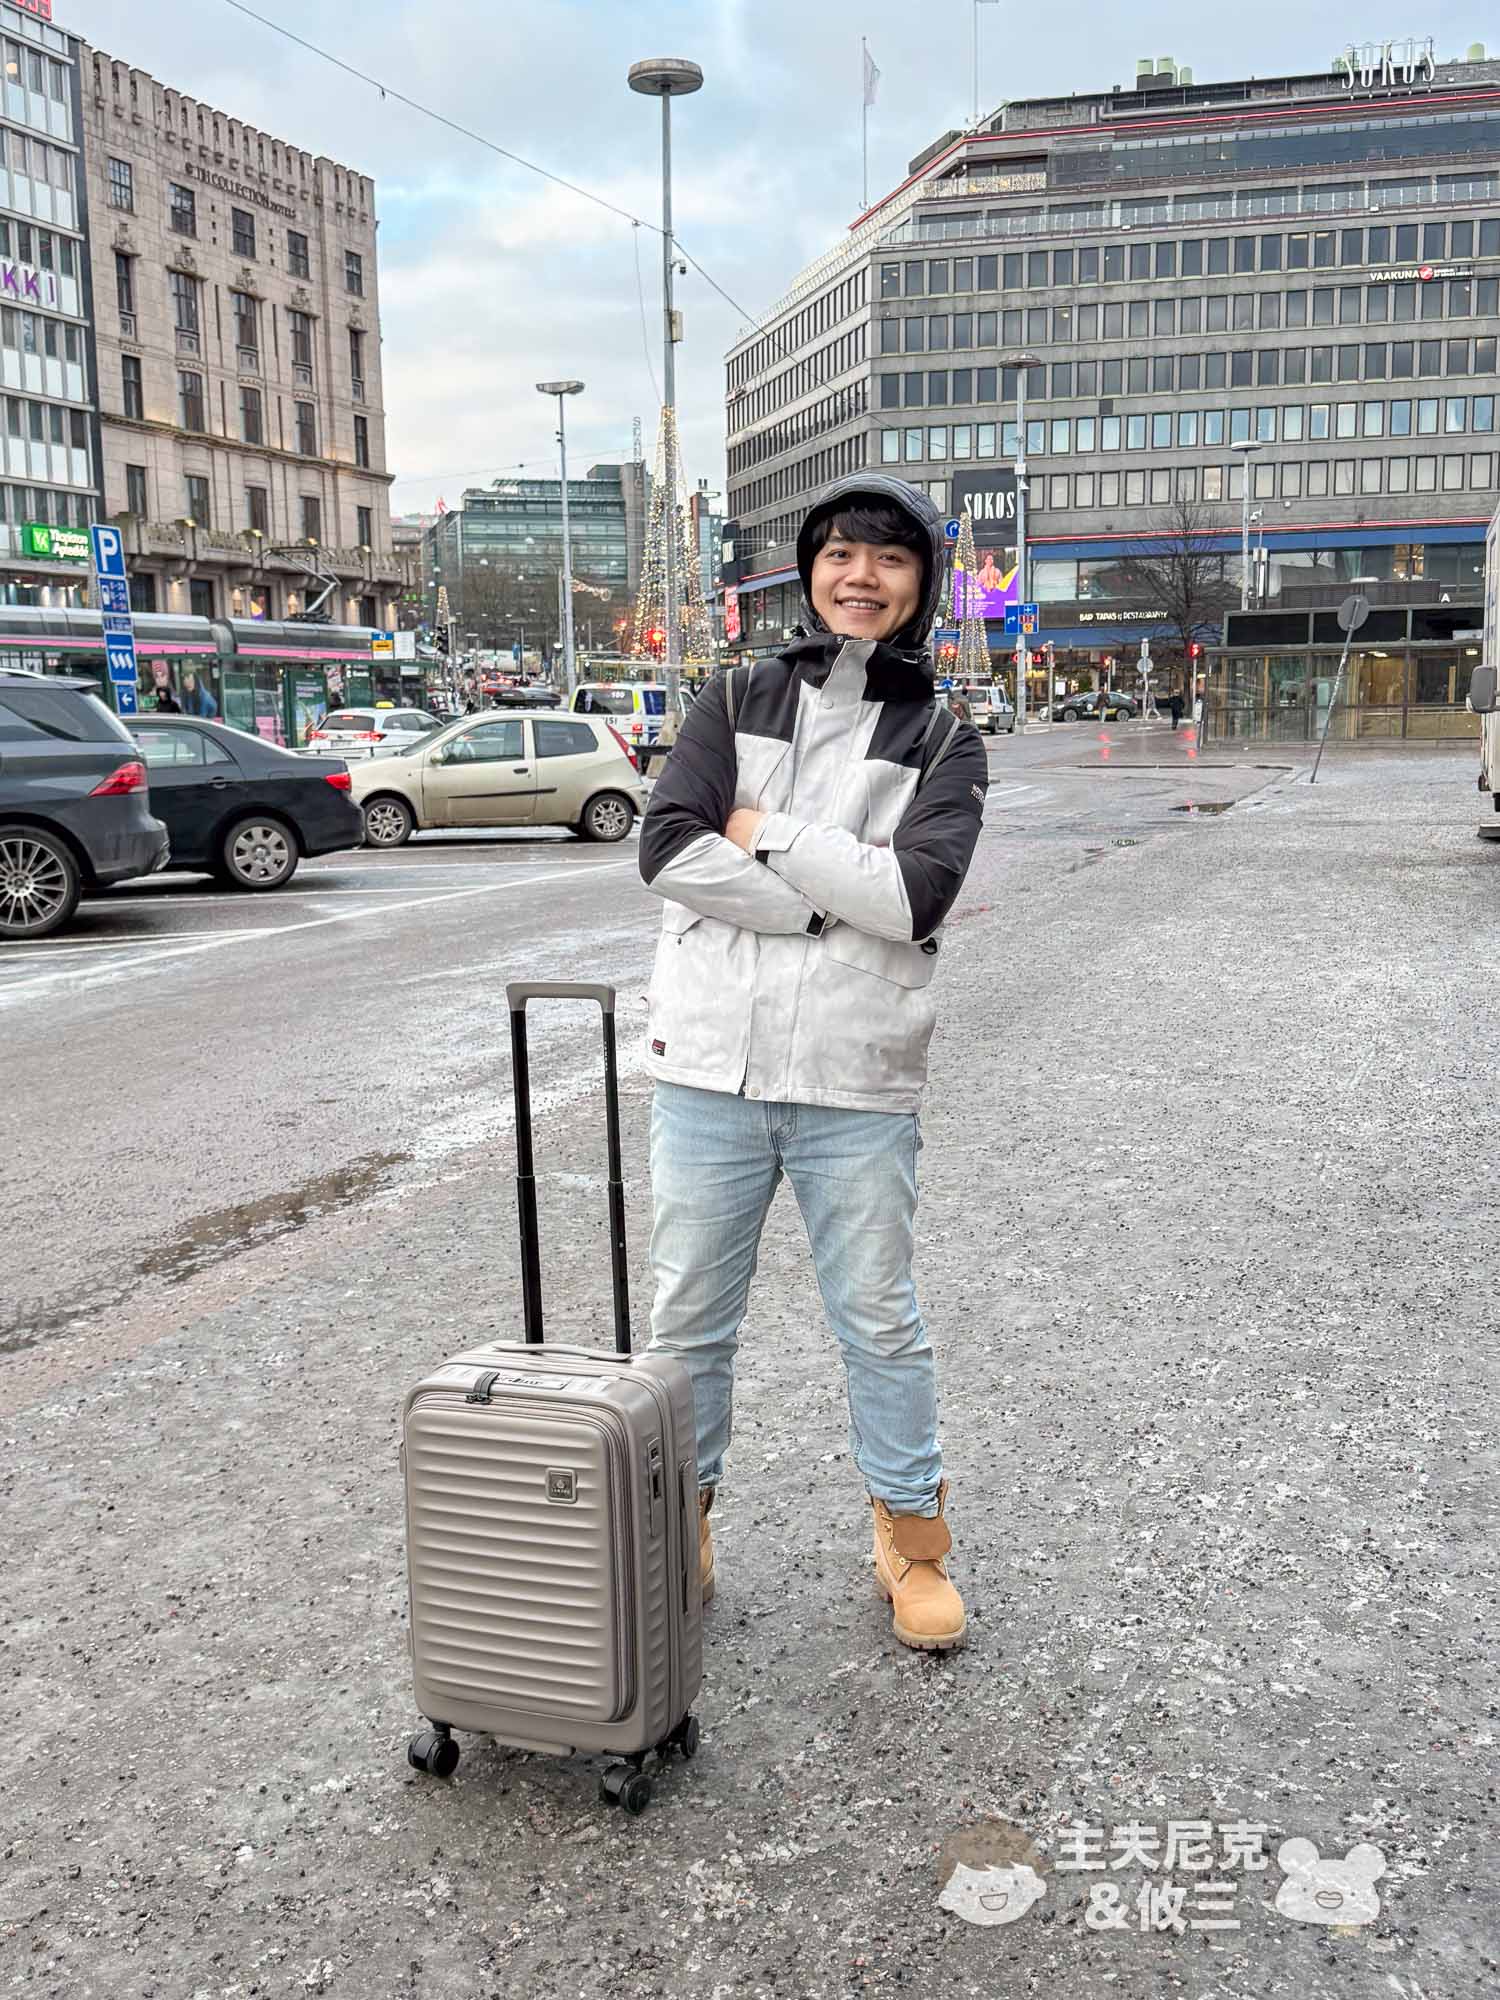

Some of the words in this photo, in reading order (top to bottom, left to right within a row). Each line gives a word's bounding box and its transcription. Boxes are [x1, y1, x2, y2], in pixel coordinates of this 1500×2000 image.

[1341, 36, 1435, 89] SOKOS
[1370, 269, 1419, 281] VAAKUNA
[963, 491, 1015, 520] SOKOS
[98, 529, 118, 572] P
[1441, 593, 1450, 603] A
